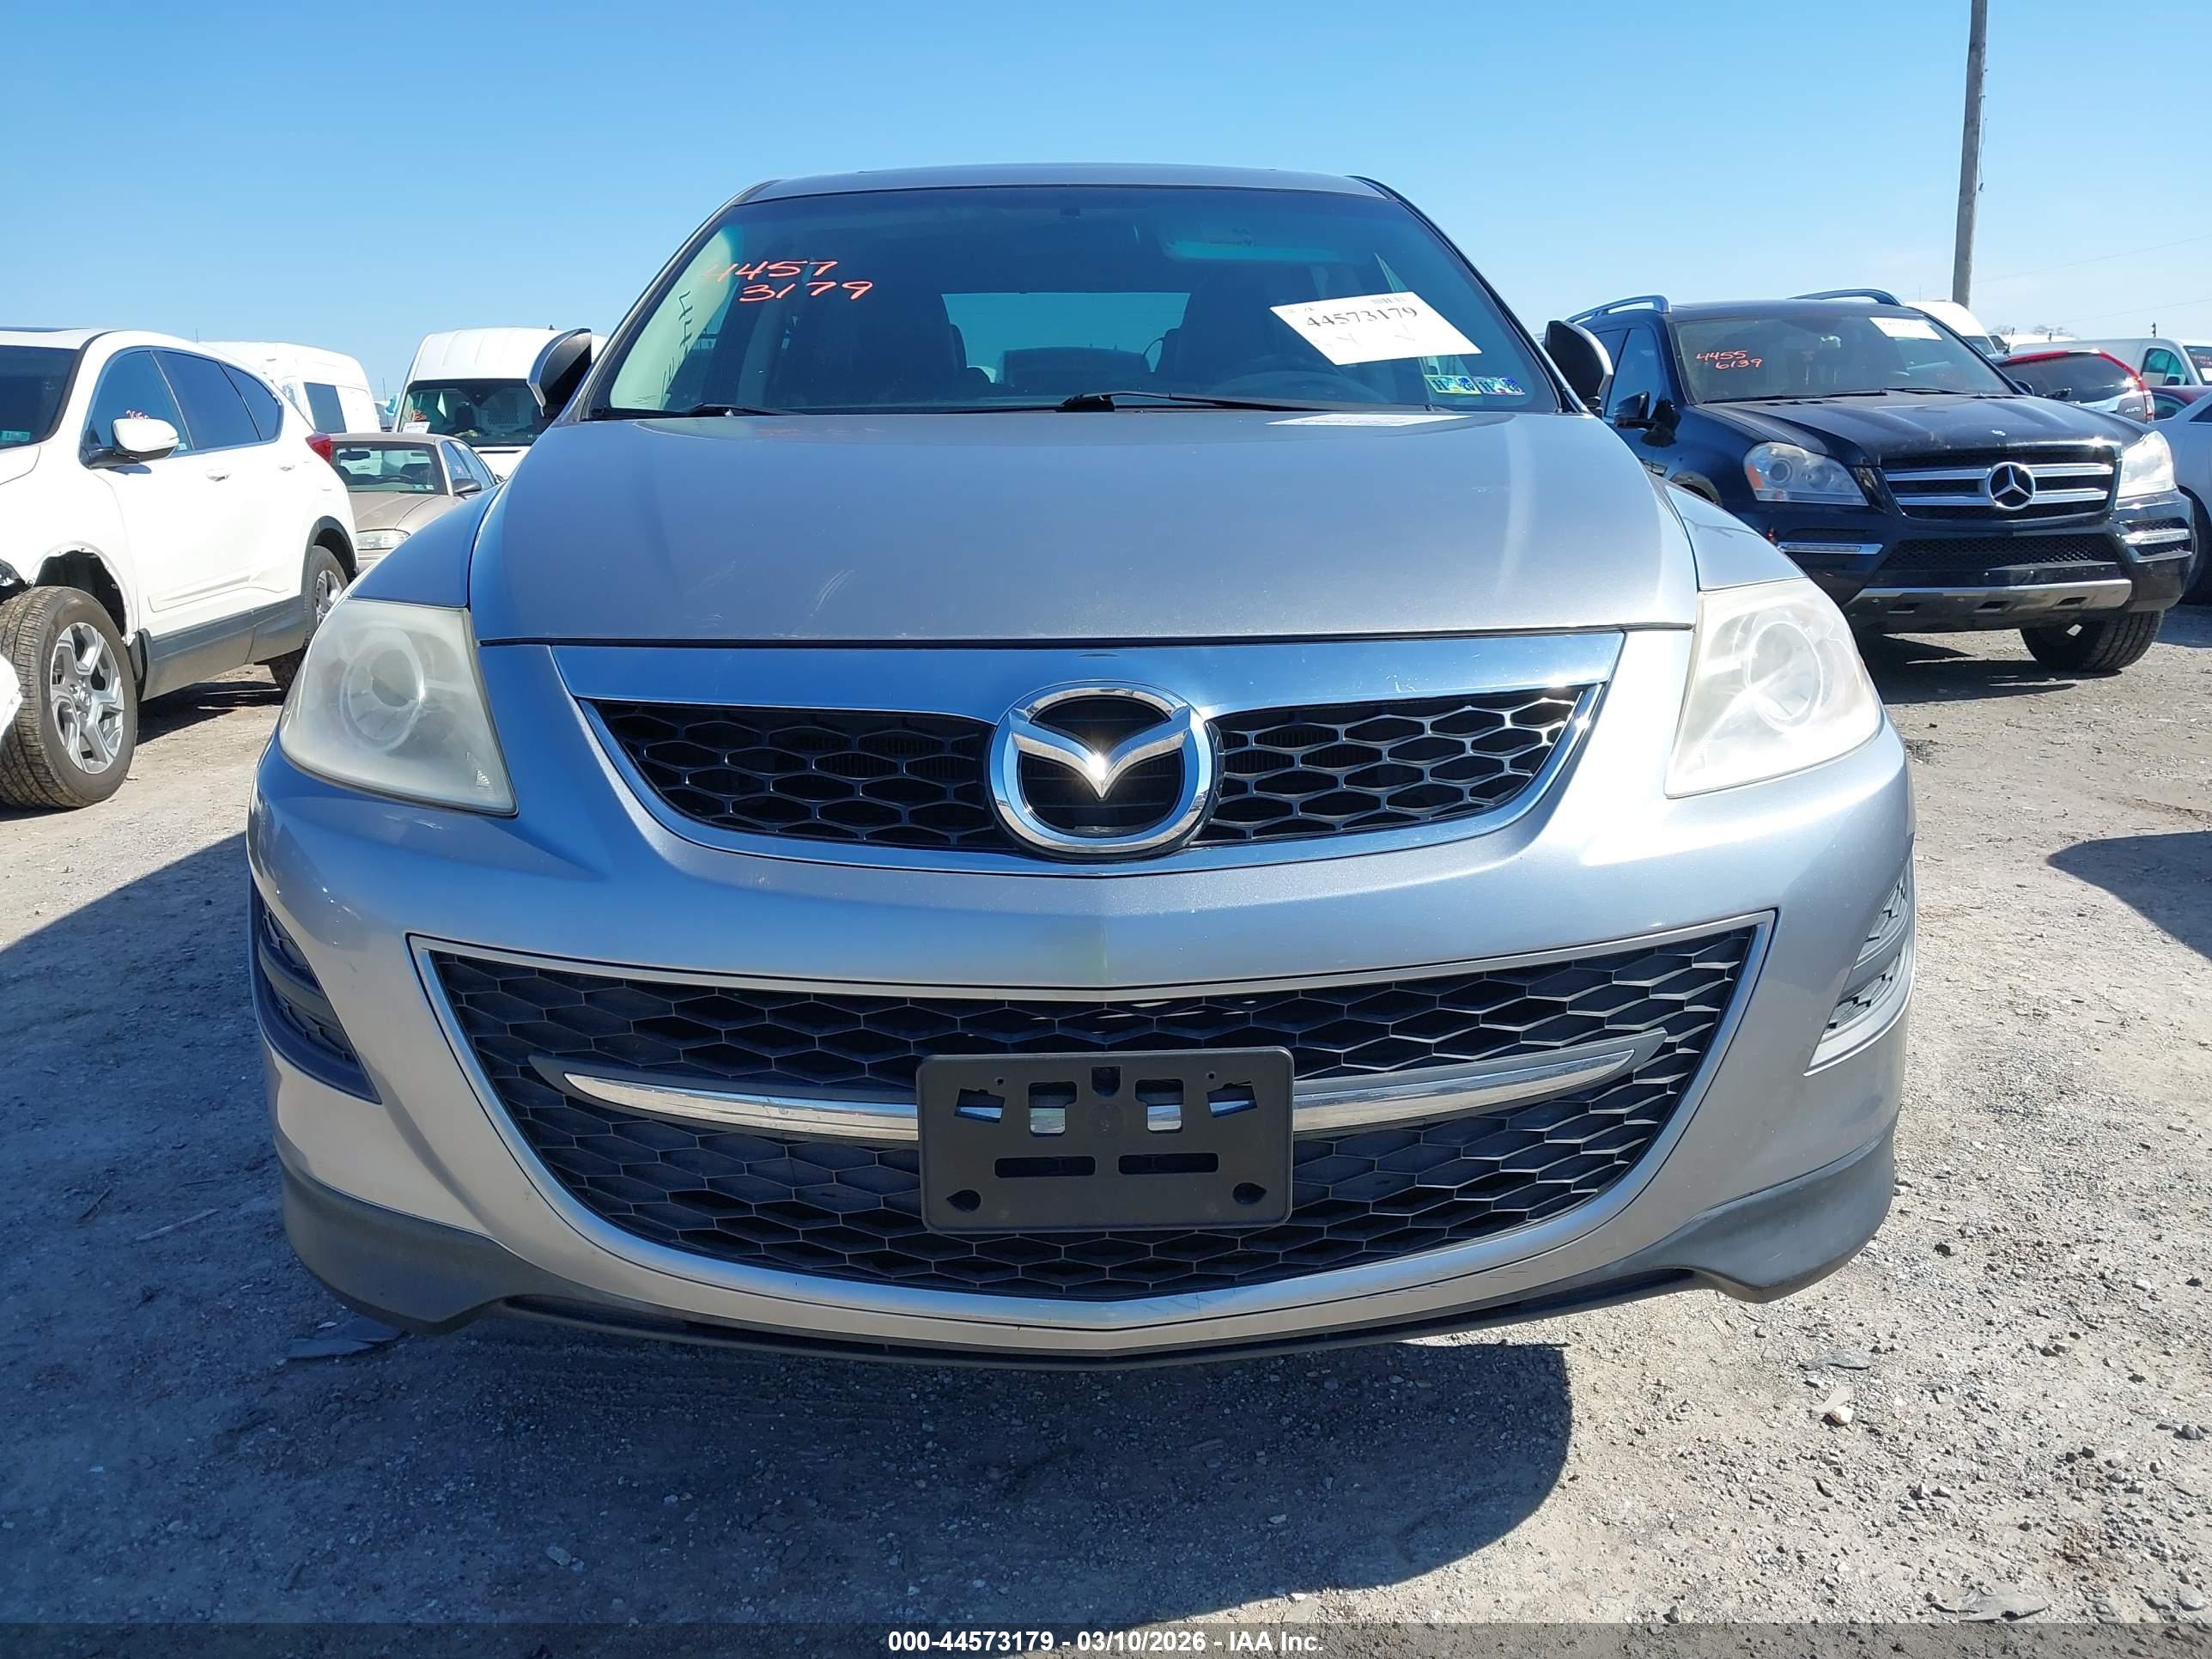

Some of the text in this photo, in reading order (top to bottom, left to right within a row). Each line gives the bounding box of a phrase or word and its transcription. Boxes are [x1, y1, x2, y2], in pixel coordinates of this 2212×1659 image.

[701, 260, 839, 283] 4457
[738, 281, 873, 302] 3179
[1306, 306, 1418, 328] 44573179
[1696, 349, 1748, 362] 4455
[1715, 357, 1763, 370] 6139
